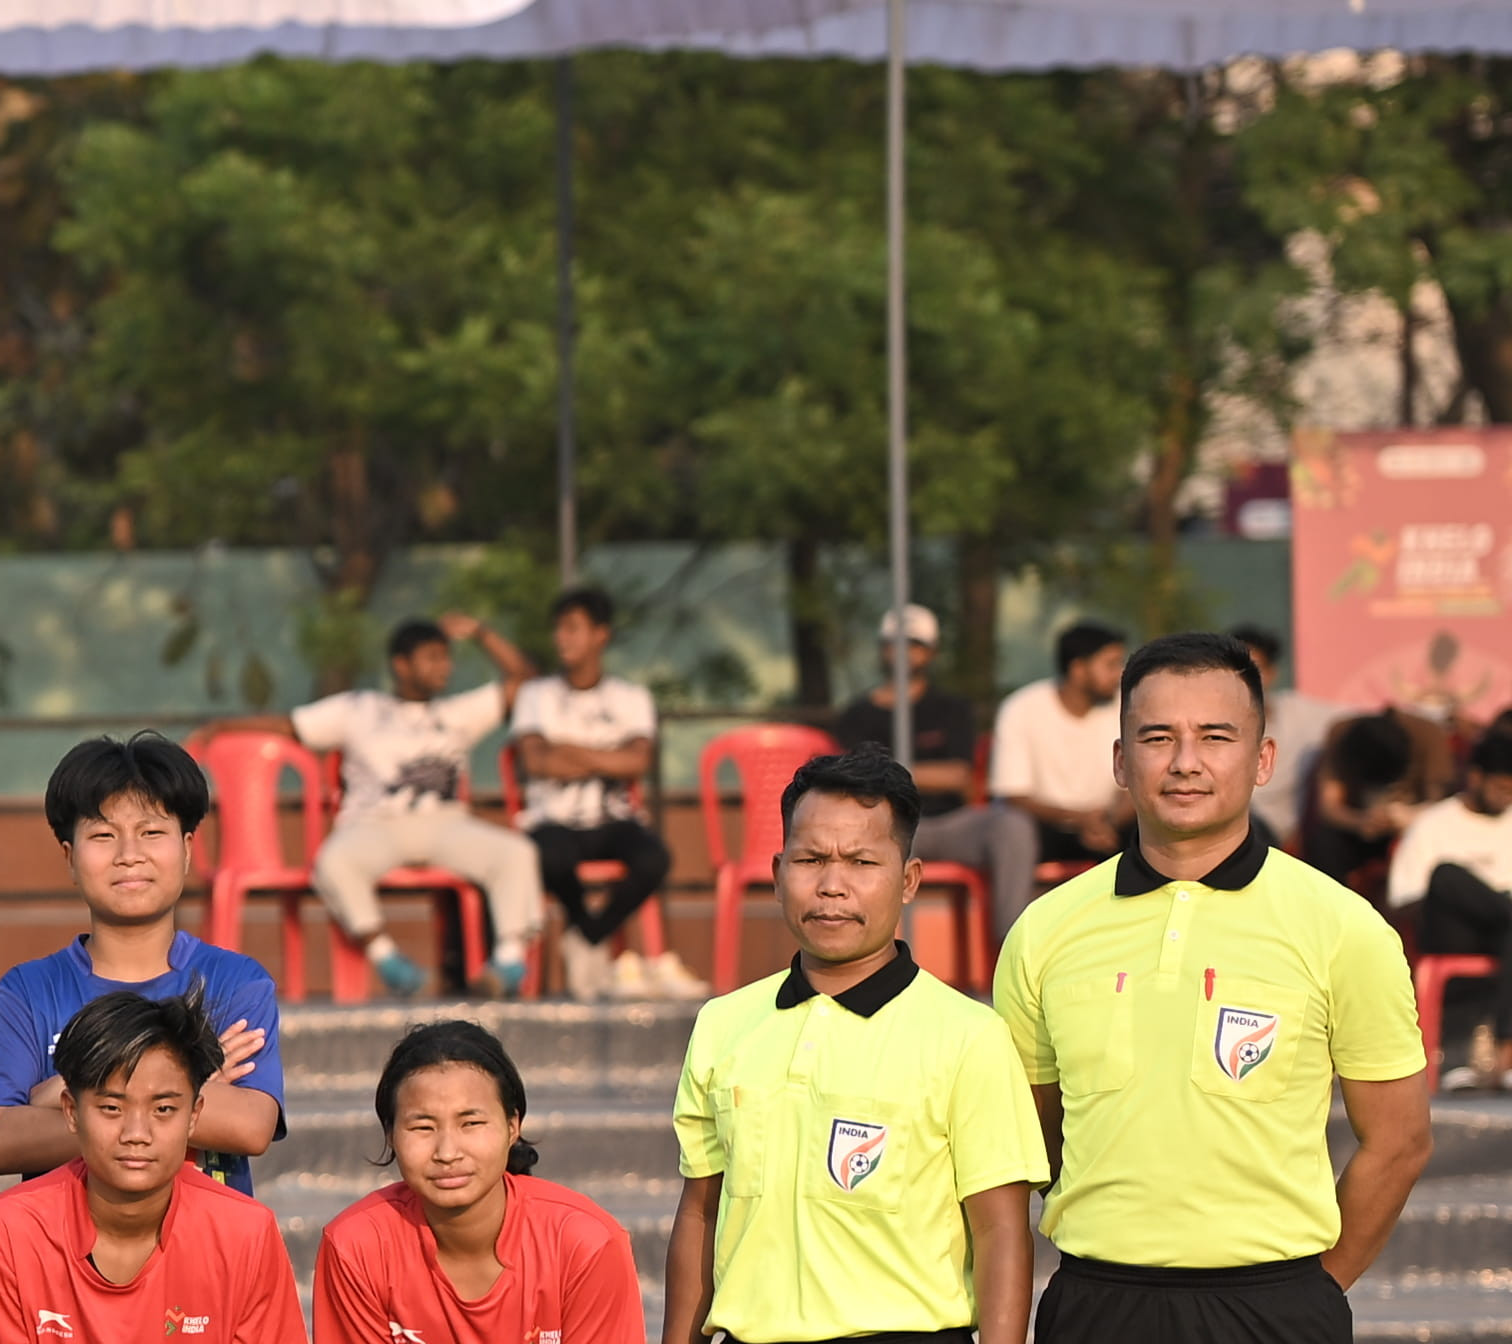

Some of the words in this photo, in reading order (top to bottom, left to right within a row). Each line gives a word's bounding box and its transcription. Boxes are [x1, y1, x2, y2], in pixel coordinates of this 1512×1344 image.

[1226, 1014, 1260, 1029] INDIA
[838, 1125, 869, 1139] INDIA
[182, 1315, 209, 1326] KHELO
[181, 1323, 204, 1335] INDIA
